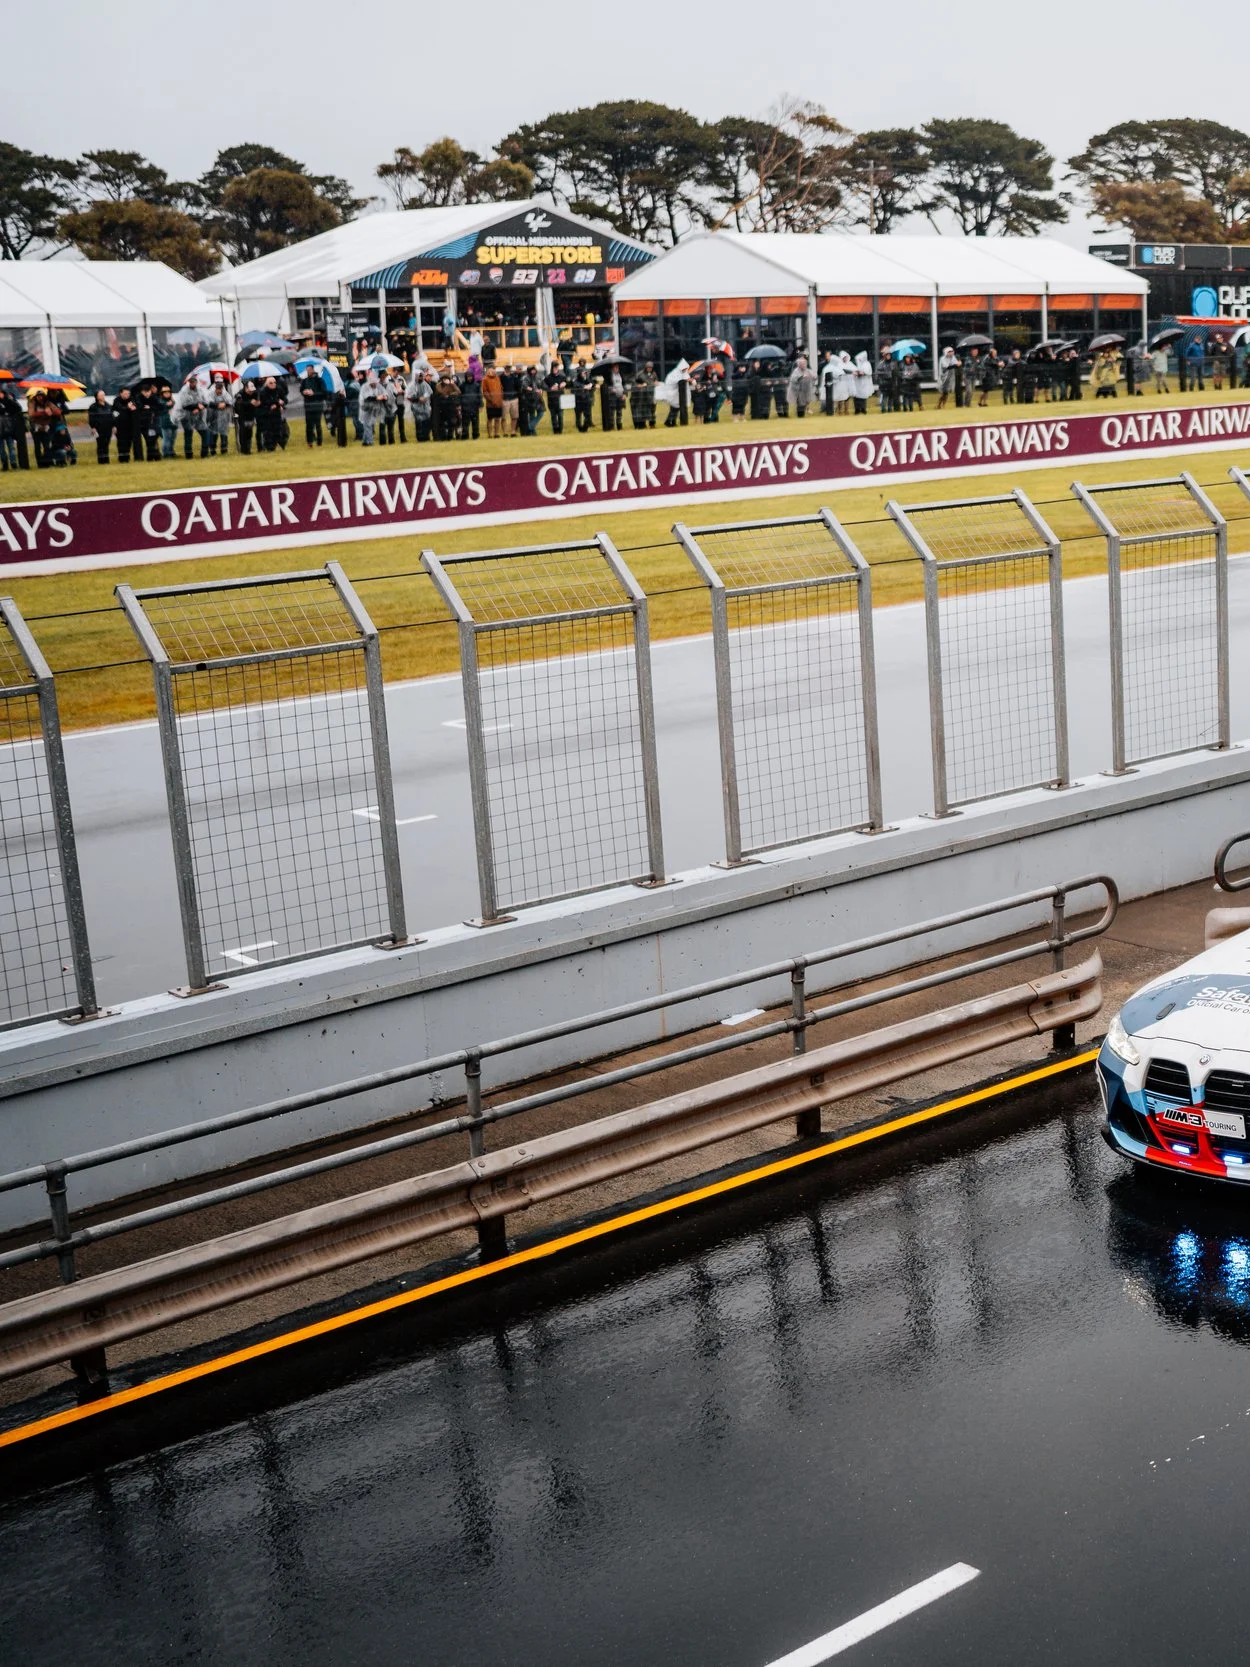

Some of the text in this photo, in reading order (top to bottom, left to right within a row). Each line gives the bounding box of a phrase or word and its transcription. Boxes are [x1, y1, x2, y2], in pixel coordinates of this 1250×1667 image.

[485, 236, 528, 247] OFFICIAL
[476, 246, 603, 265] SUPERSTORE
[1153, 247, 1176, 256] QUAD
[410, 269, 449, 286] KTM
[511, 269, 539, 285] 93
[547, 268, 566, 284] 23
[573, 269, 597, 284] 89
[1101, 410, 1183, 449] QATAR
[849, 421, 1070, 472] QATAR AIRWAYS
[536, 442, 810, 500] QATAR AIRWAYS
[141, 469, 487, 541] QATAR AIRWAYS
[1205, 1121, 1237, 1132] TOURING
